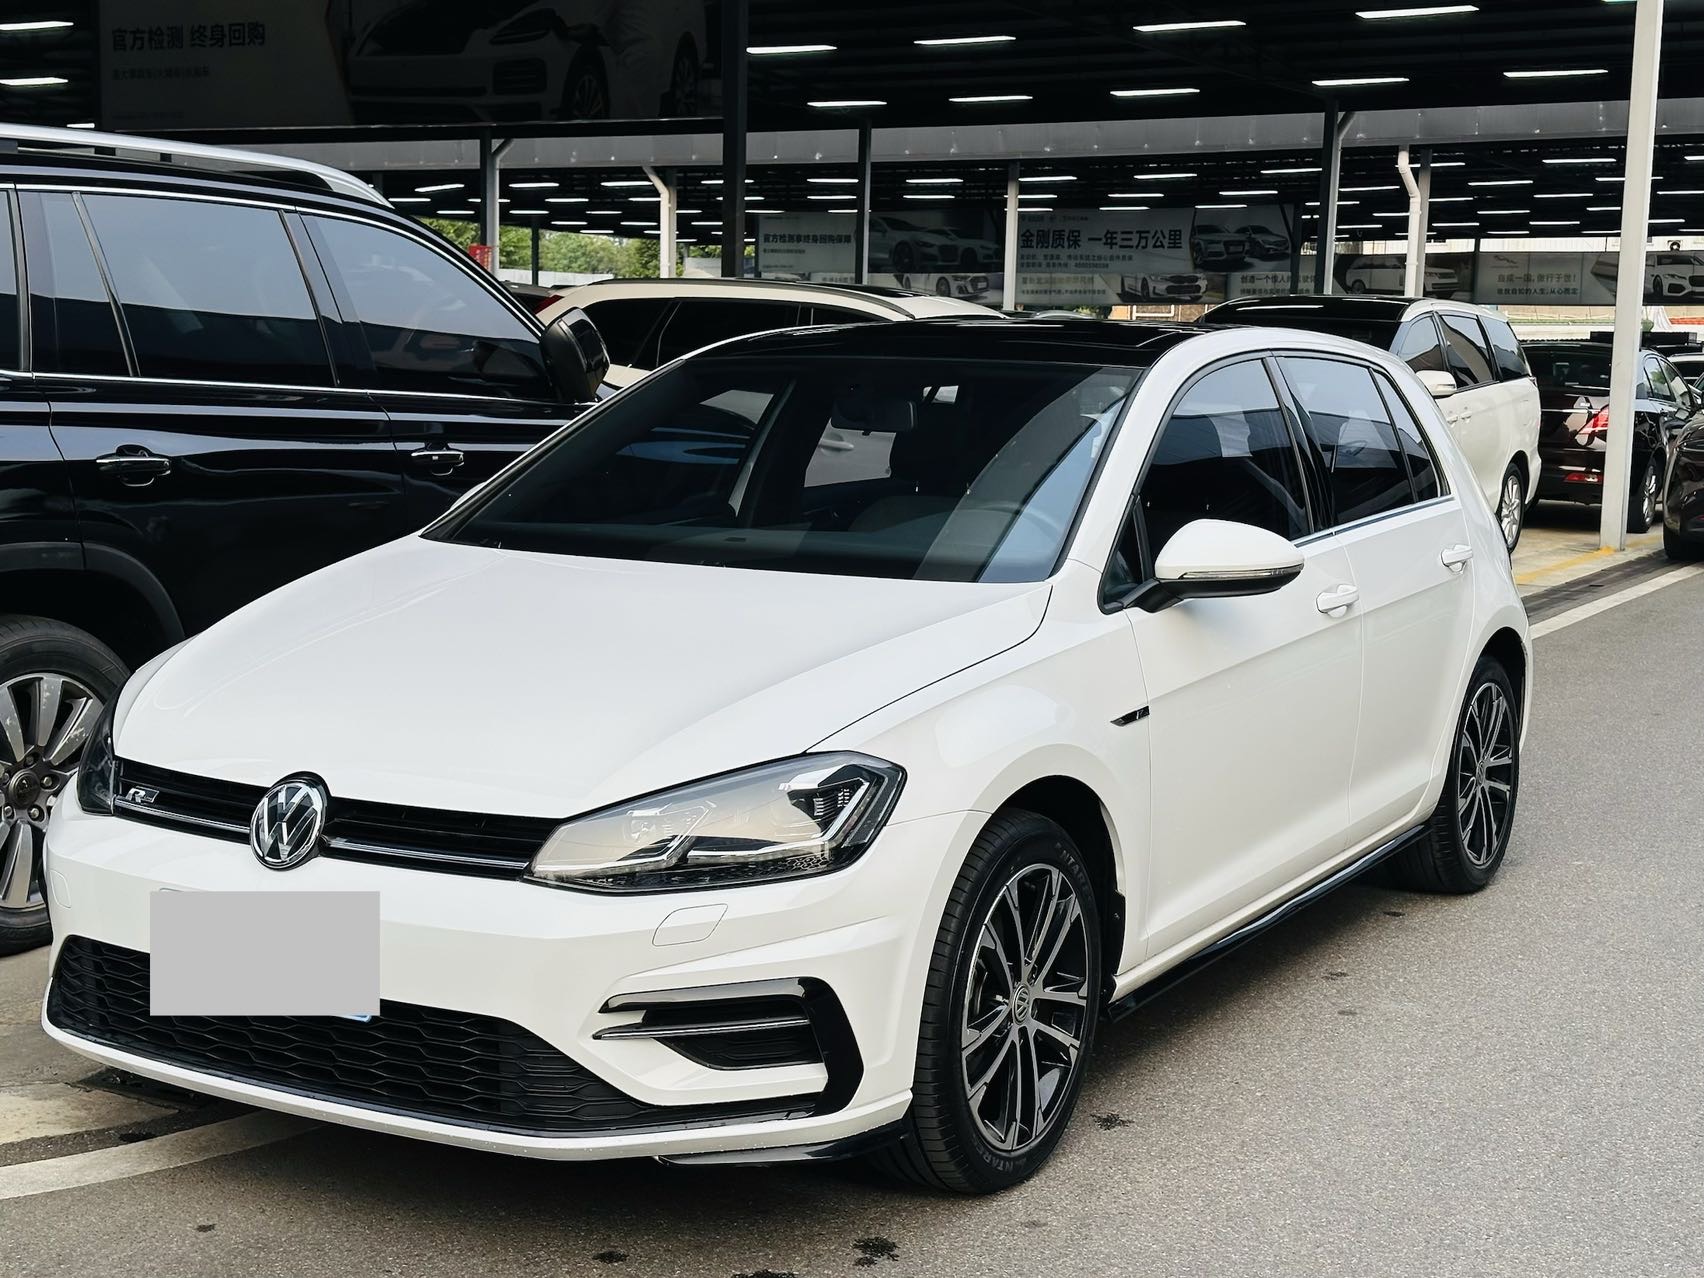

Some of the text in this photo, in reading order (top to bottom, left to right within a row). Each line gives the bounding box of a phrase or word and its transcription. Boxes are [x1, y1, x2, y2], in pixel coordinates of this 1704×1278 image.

[111, 22, 265, 51] 官方检测 终身回购
[1020, 229, 1183, 249] 金刚质保 一年三万公里
